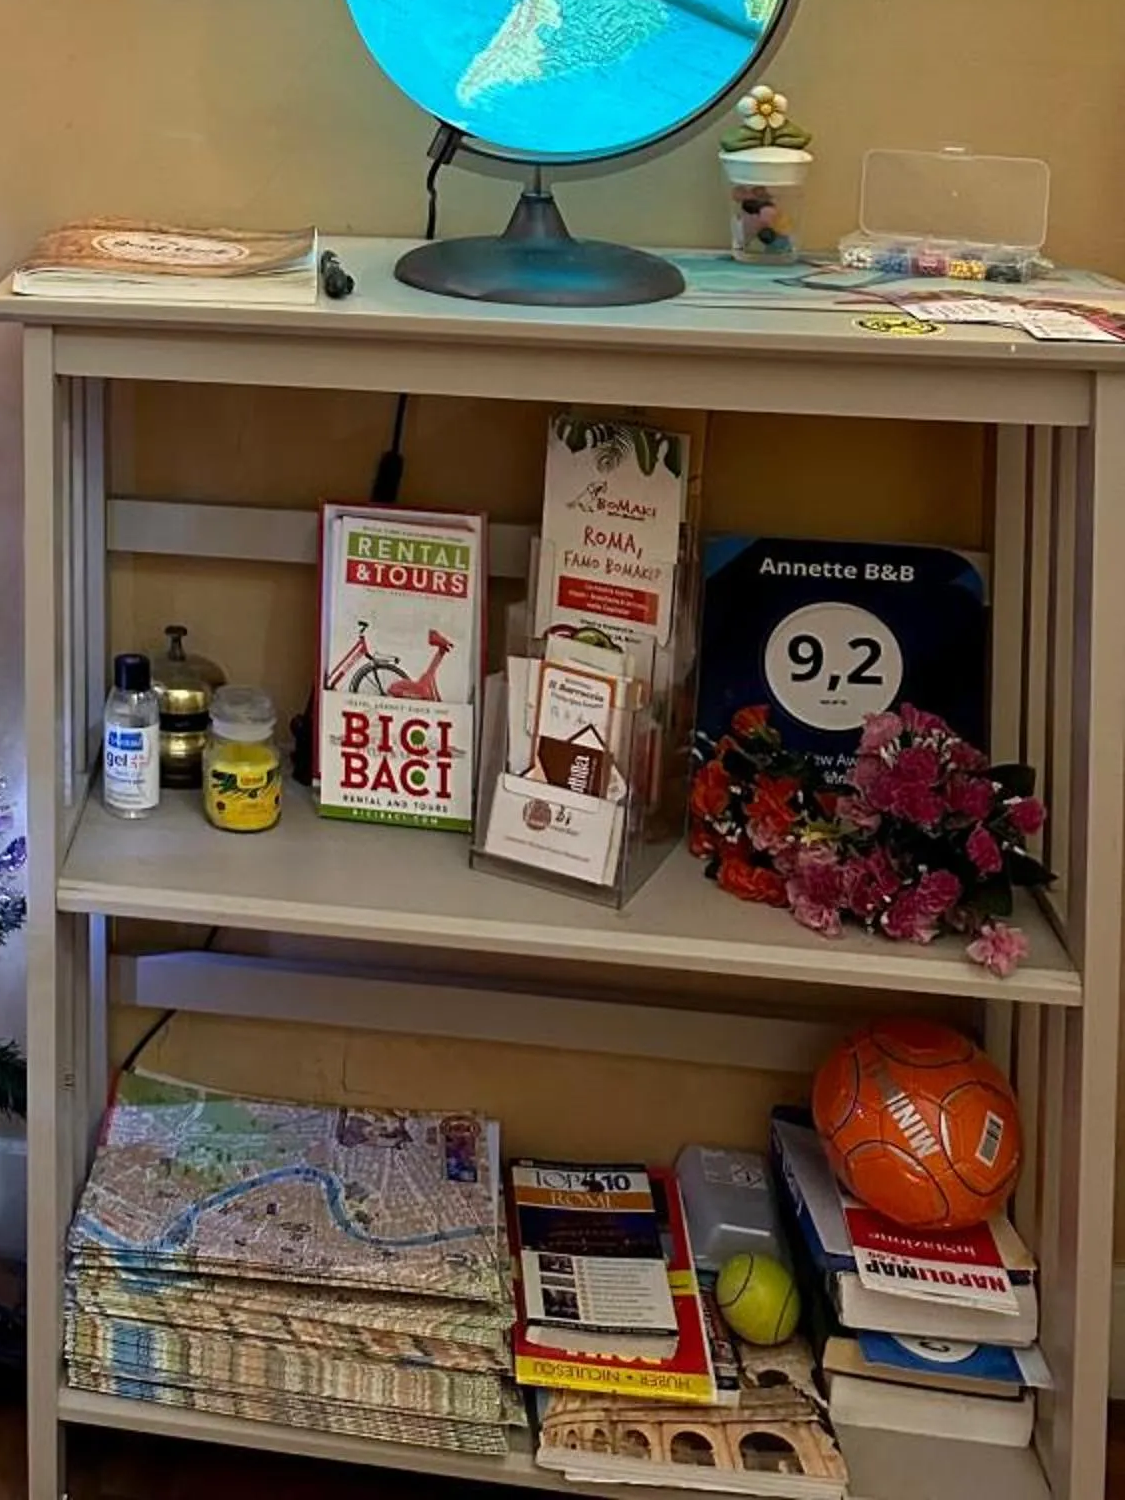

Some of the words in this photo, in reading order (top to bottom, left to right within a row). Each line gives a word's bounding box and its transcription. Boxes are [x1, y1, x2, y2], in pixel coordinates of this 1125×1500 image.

[357, 535, 468, 570] RENTAL
[583, 525, 644, 560] ROMA,
[564, 550, 600, 570] FAMO
[760, 556, 858, 580] Annette
[864, 562, 915, 582] B&B
[355, 562, 467, 594] &TOURS
[787, 634, 883, 692] 9,2
[341, 710, 453, 759] BICI
[106, 751, 128, 767] gel
[339, 751, 452, 799] BACI
[342, 794, 380, 805] RENTAL
[387, 799, 408, 809] AND
[414, 802, 448, 814] TOURS
[601, 1173, 632, 1191] 10
[865, 1259, 1007, 1293] NAPOLIMAP
